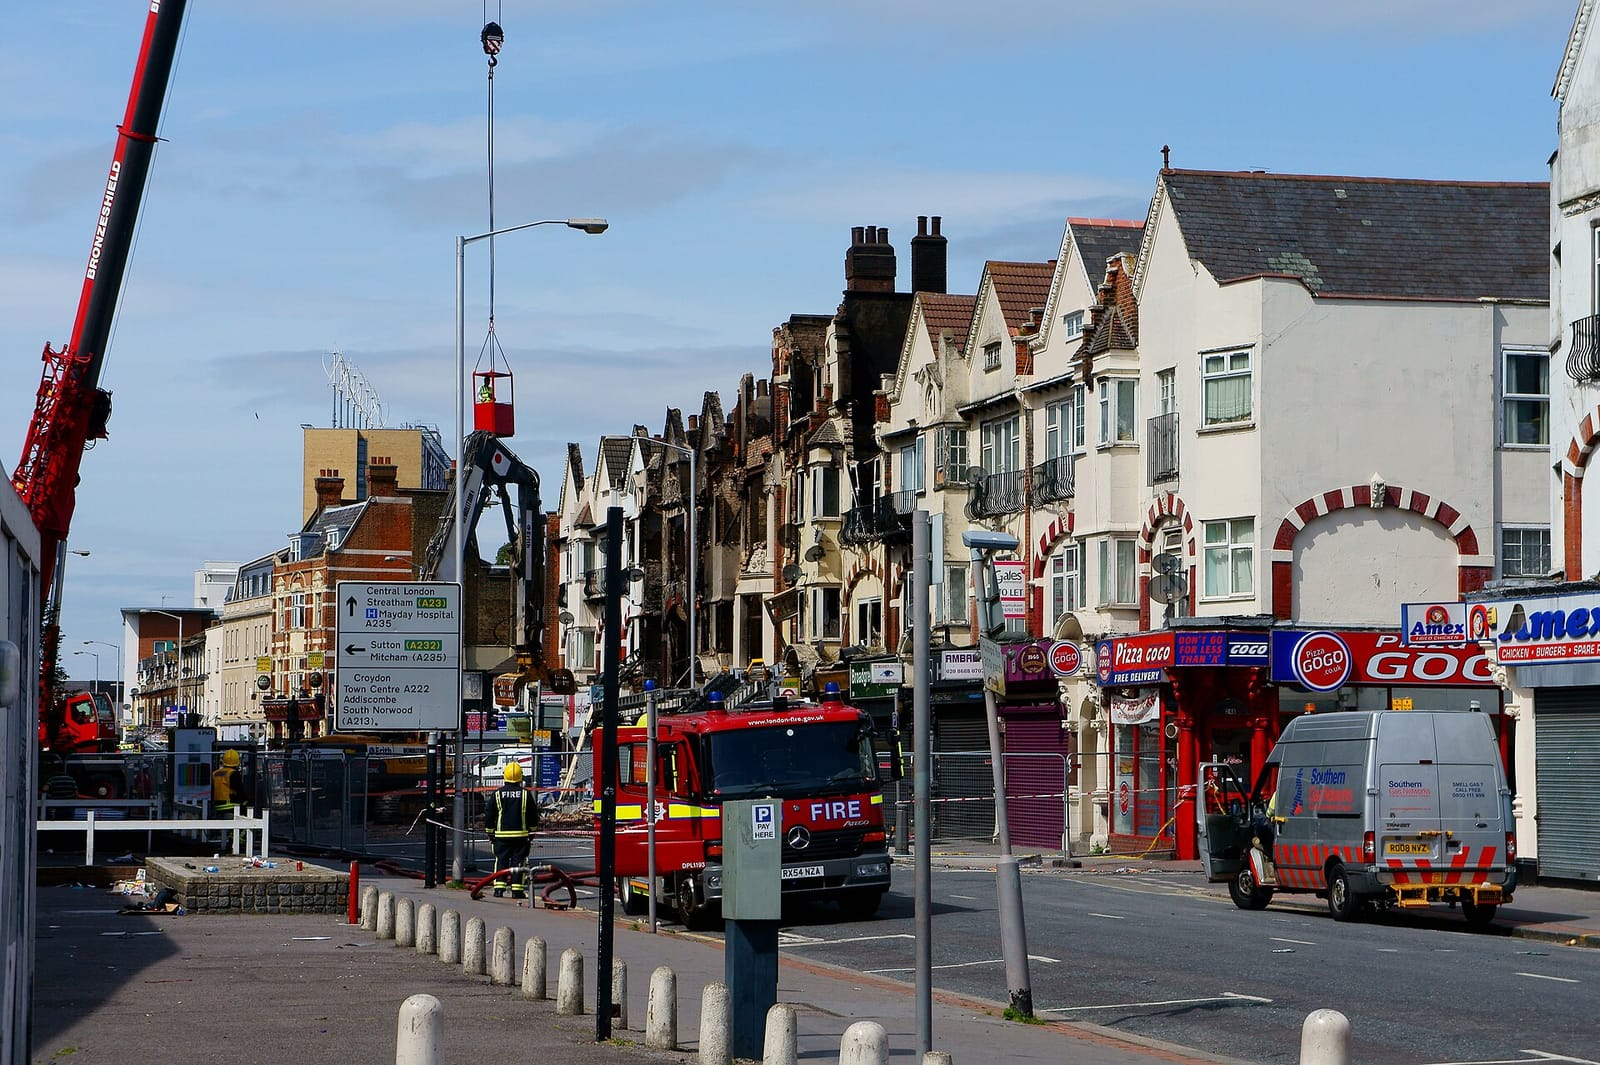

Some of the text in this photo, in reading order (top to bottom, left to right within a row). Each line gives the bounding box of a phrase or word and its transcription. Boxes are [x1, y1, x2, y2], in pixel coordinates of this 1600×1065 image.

[86, 160, 121, 280] BRONZESHIELD
[366, 587, 435, 596] Central London
[1010, 588, 1023, 596] LET
[367, 598, 446, 608] Streatham (A23)
[379, 610, 412, 620] Mayday
[416, 610, 454, 620] Hospital
[366, 620, 392, 628] A235
[1410, 621, 1464, 636] Amex
[370, 640, 441, 650] Sutton (A232)
[1178, 636, 1223, 645] DON'T GO
[1116, 642, 1170, 665] Pizza GOGO
[1179, 646, 1222, 654] FOR LESS
[1230, 644, 1268, 655] GOGO
[1306, 648, 1325, 659] Pizza
[1501, 648, 1529, 659] CHICKEN
[1536, 645, 1566, 657] BURGERS
[1573, 644, 1595, 655] SPARE
[370, 653, 447, 662] Mitcham (A235)
[1055, 653, 1077, 664] GOGO
[1180, 656, 1205, 664] THAN
[1302, 650, 1344, 674] GOGO
[354, 674, 391, 684] Croydon
[1114, 670, 1160, 683] FREE DELIVERY
[344, 685, 430, 693] Town Centre A222
[344, 696, 397, 704] Addiscombe
[344, 706, 413, 714] South Norwood
[748, 714, 824, 727] www.london-fire.gov.uk
[1311, 768, 1346, 784] Southern
[1388, 780, 1422, 788] Southern
[759, 808, 770, 820] P
[810, 800, 861, 821] FIRE
[754, 831, 774, 839] HERE
[1411, 844, 1427, 852] NVZ
[682, 862, 706, 870] DPL1193
[782, 867, 820, 878] RX54 NZA
